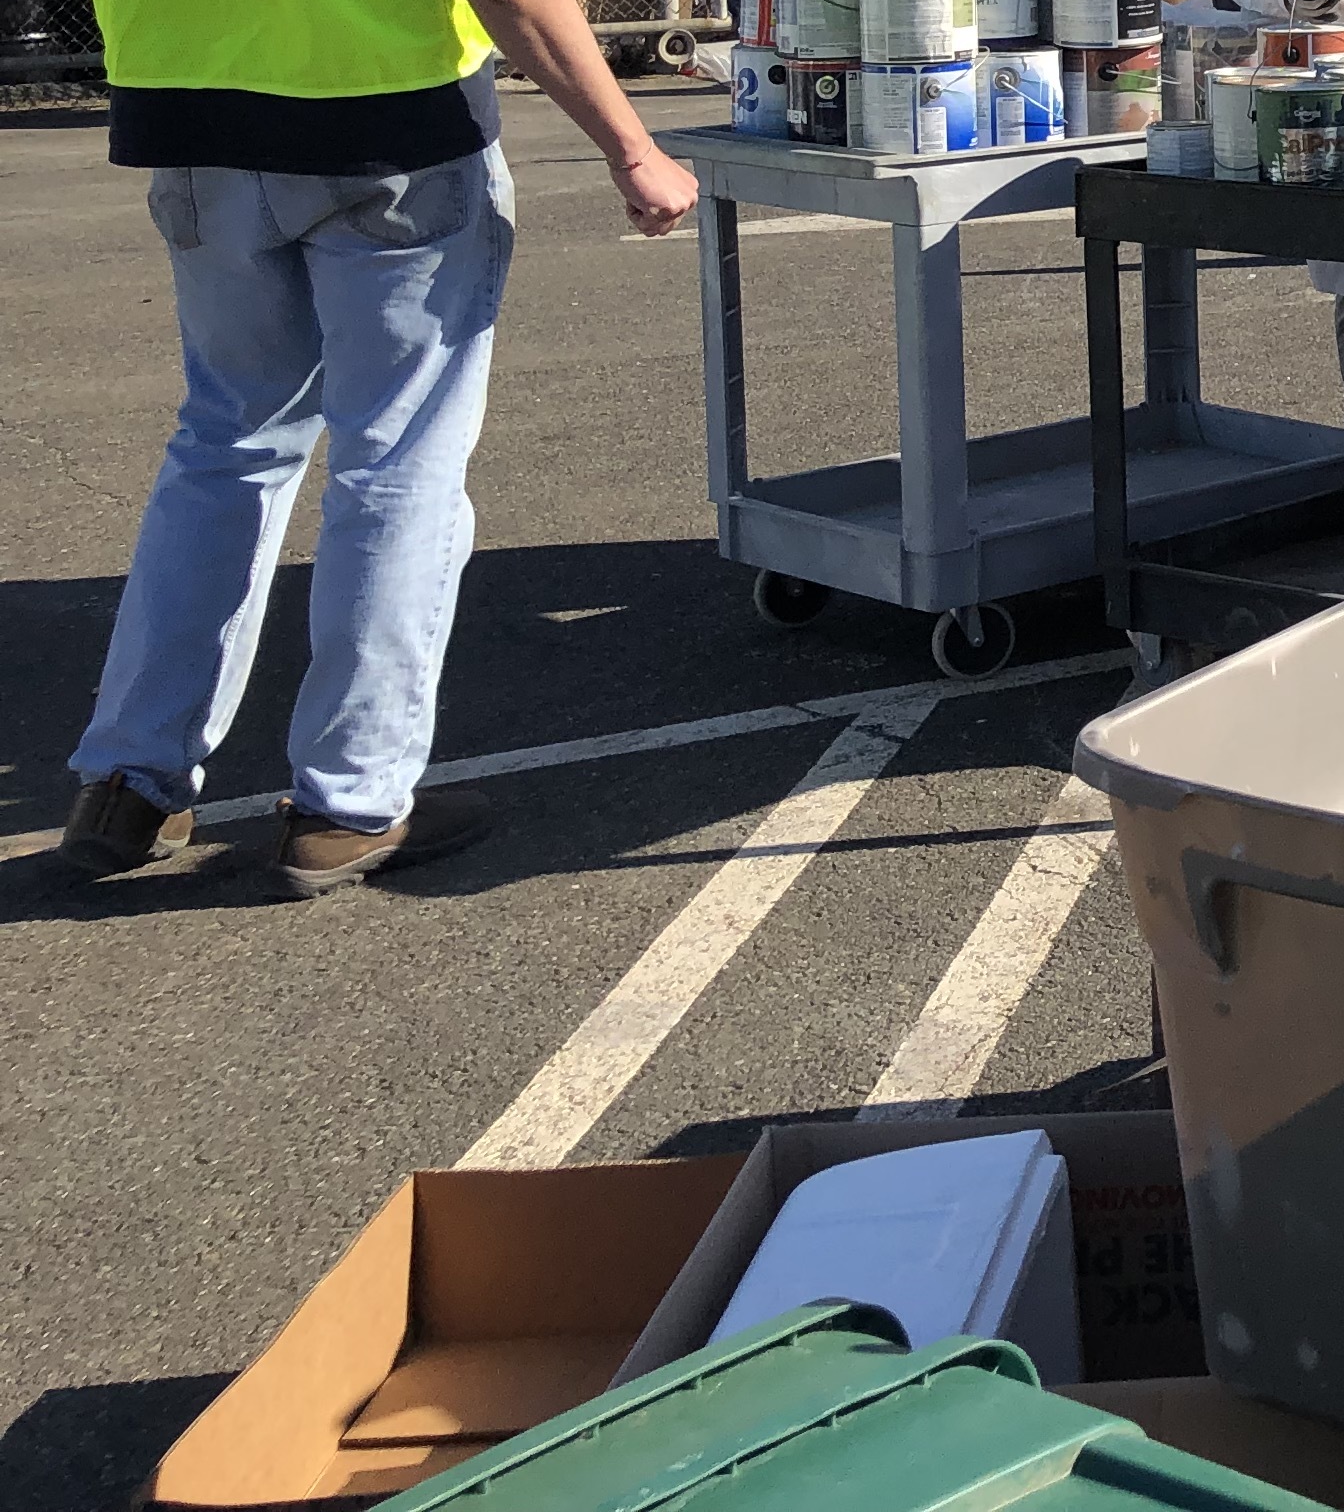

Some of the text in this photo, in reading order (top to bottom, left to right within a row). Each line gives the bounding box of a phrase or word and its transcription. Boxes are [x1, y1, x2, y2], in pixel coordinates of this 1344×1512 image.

[738, 67, 759, 112] 2
[1145, 1233, 1190, 1274] HE
[1103, 1284, 1199, 1327] ACK
